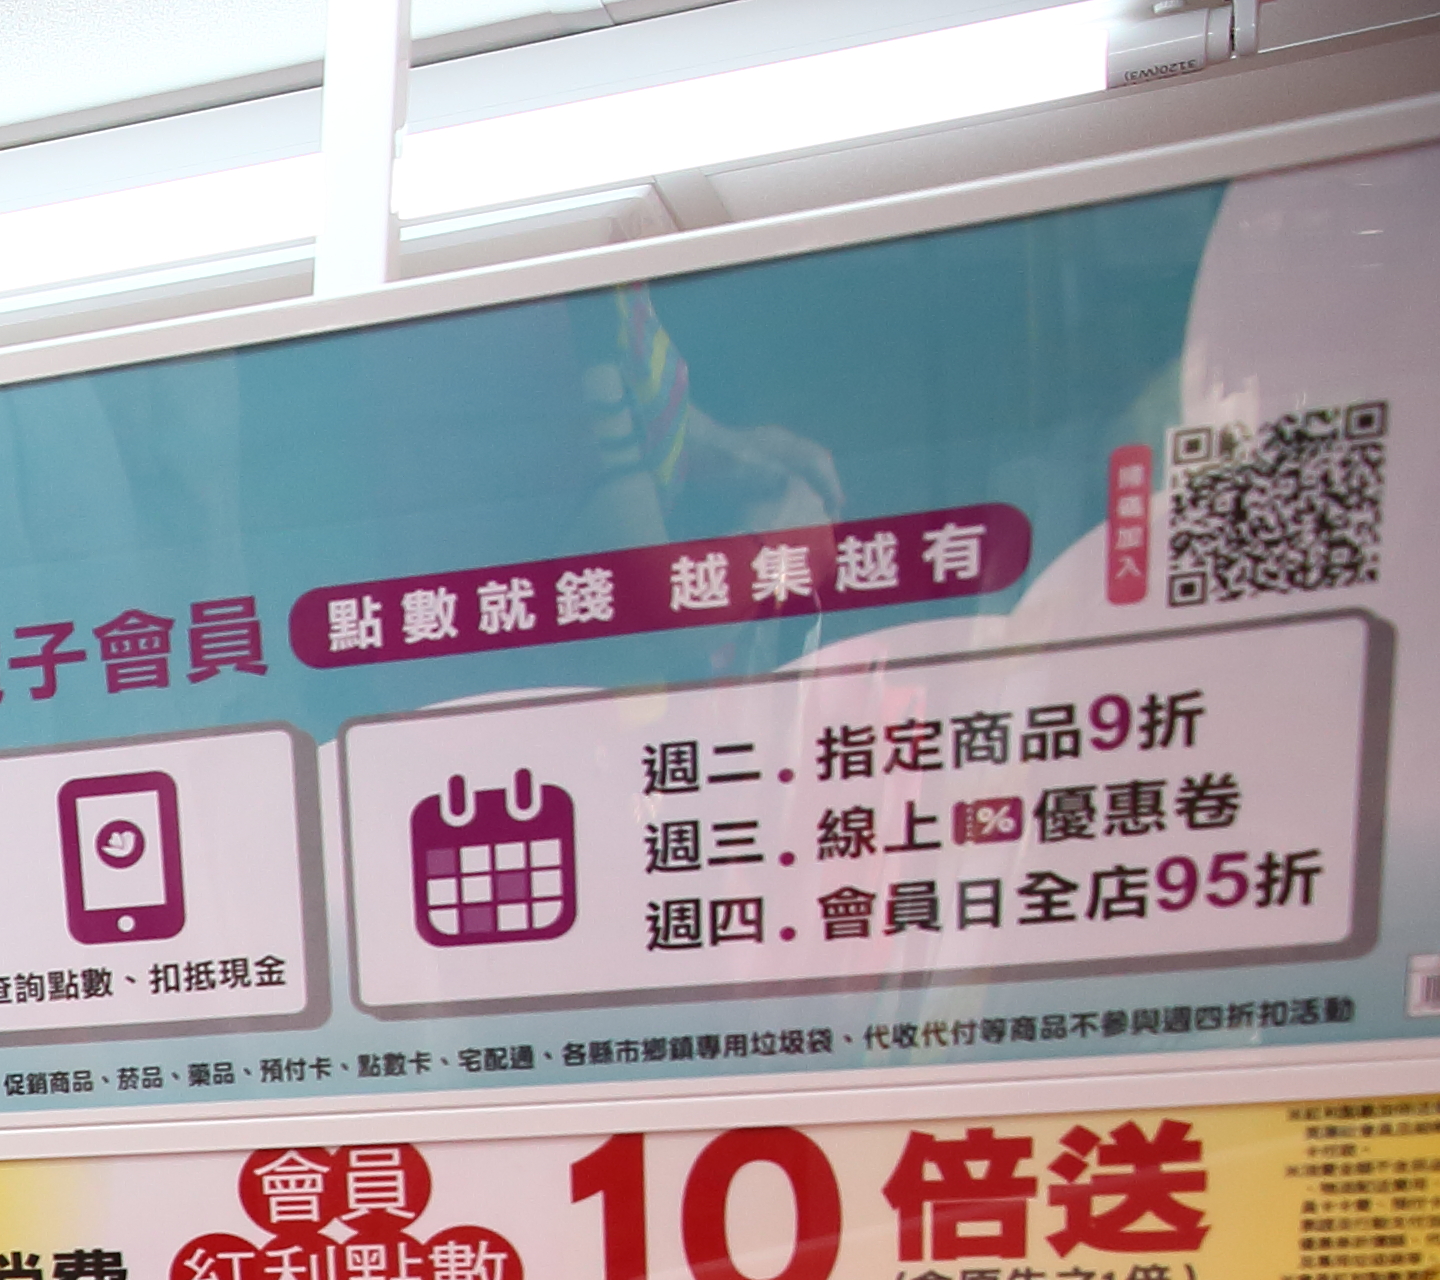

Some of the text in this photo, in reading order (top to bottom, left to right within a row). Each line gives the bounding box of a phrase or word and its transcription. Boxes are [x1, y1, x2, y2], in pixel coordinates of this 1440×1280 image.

[327, 523, 987, 650] 點數就錢 越集越有
[254, 1147, 407, 1226] 會員
[882, 1118, 1208, 1263] 倍送
